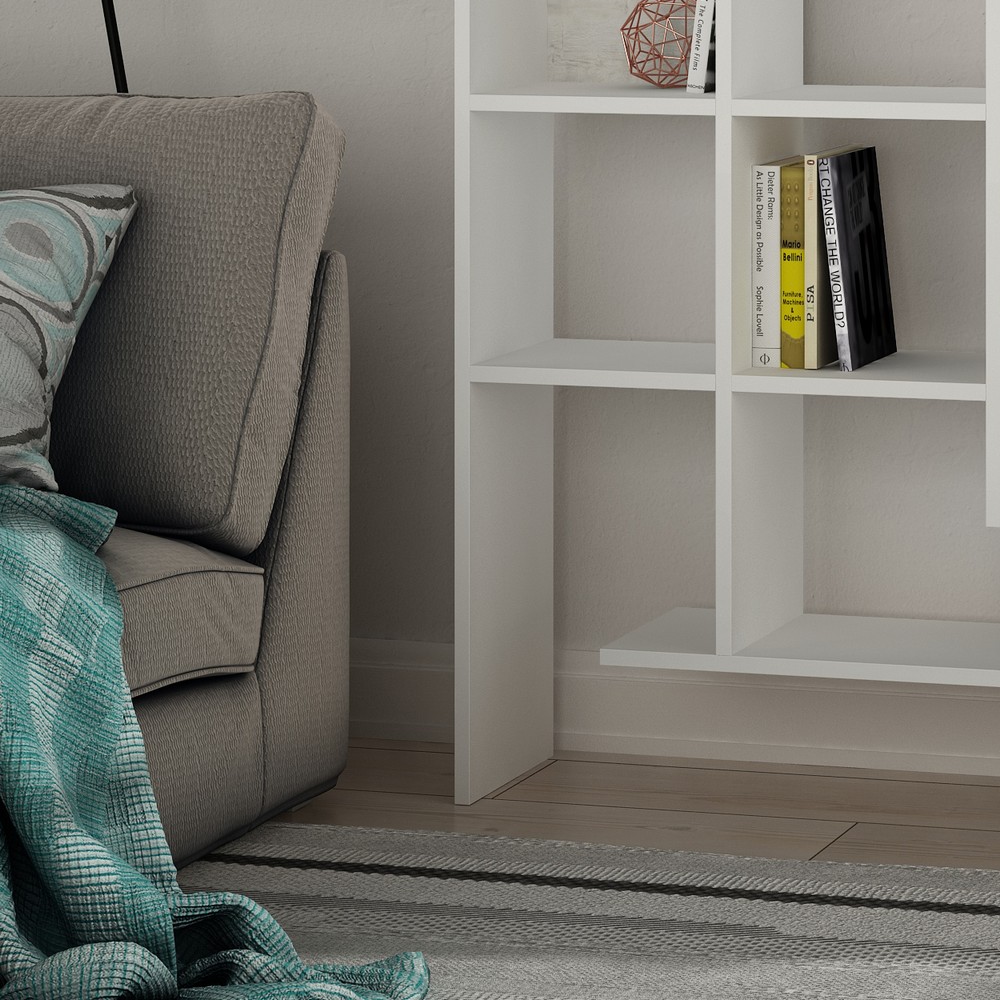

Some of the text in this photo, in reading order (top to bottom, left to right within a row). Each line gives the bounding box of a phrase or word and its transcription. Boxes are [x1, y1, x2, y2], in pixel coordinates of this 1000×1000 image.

[698, 5, 706, 17] The
[694, 19, 704, 51] Complete
[767, 171, 775, 220] Dieter Rams:
[820, 178, 836, 235] CHANGE
[755, 171, 764, 337] As Little Design as Possible Sophie Lovell
[782, 240, 801, 248] Mario
[783, 253, 802, 261] Bellini
[827, 239, 839, 266] THE
[830, 270, 846, 328] WORLD?
